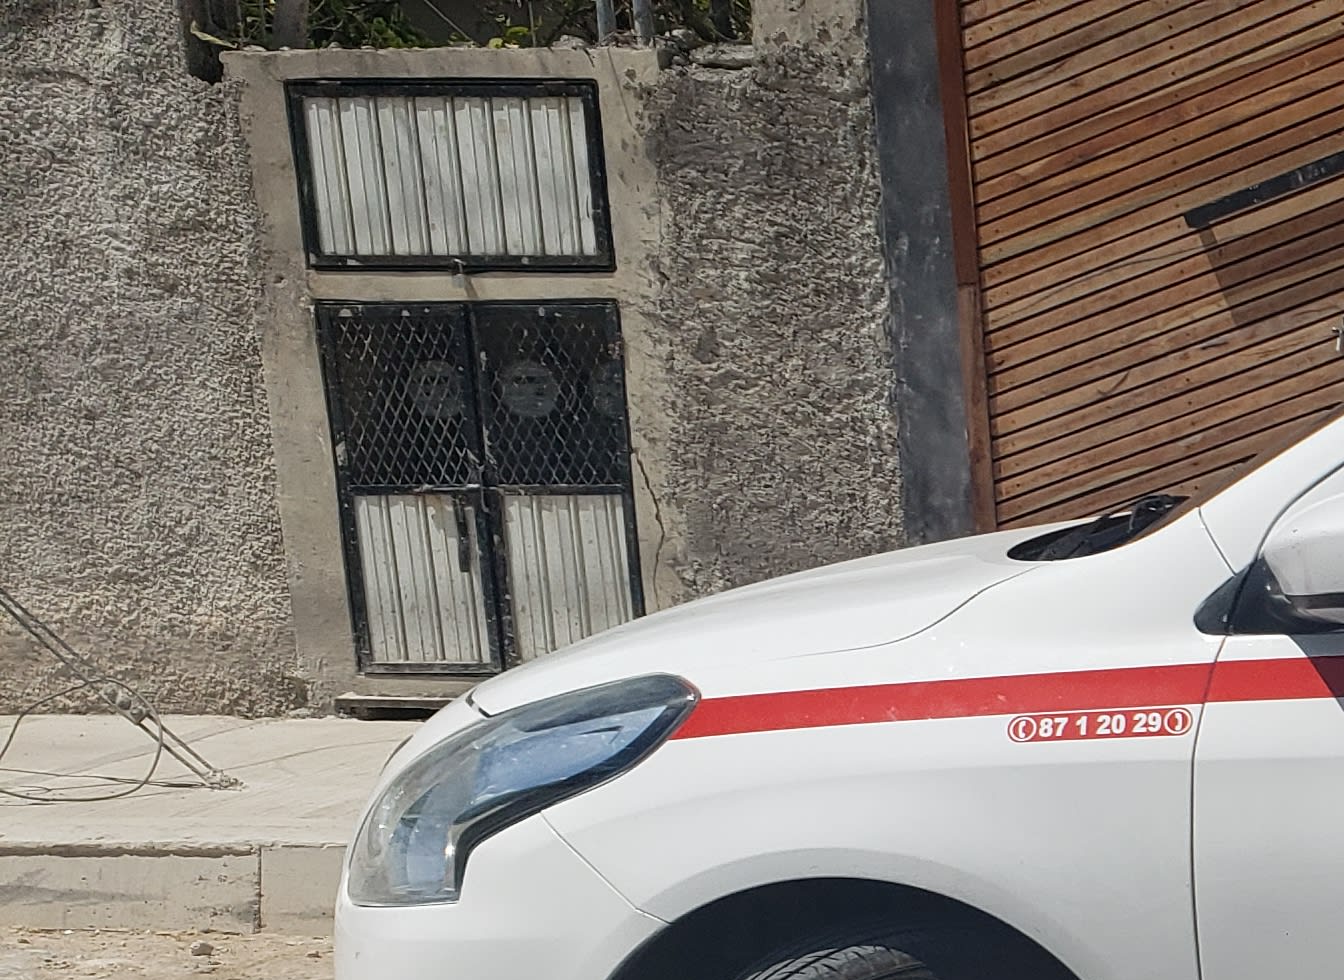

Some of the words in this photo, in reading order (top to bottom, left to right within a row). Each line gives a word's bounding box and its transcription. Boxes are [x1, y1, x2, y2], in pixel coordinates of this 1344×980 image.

[1038, 716, 1069, 738] 87
[1075, 715, 1088, 736] 1
[1095, 713, 1126, 735] 20
[1131, 712, 1162, 734] 29
